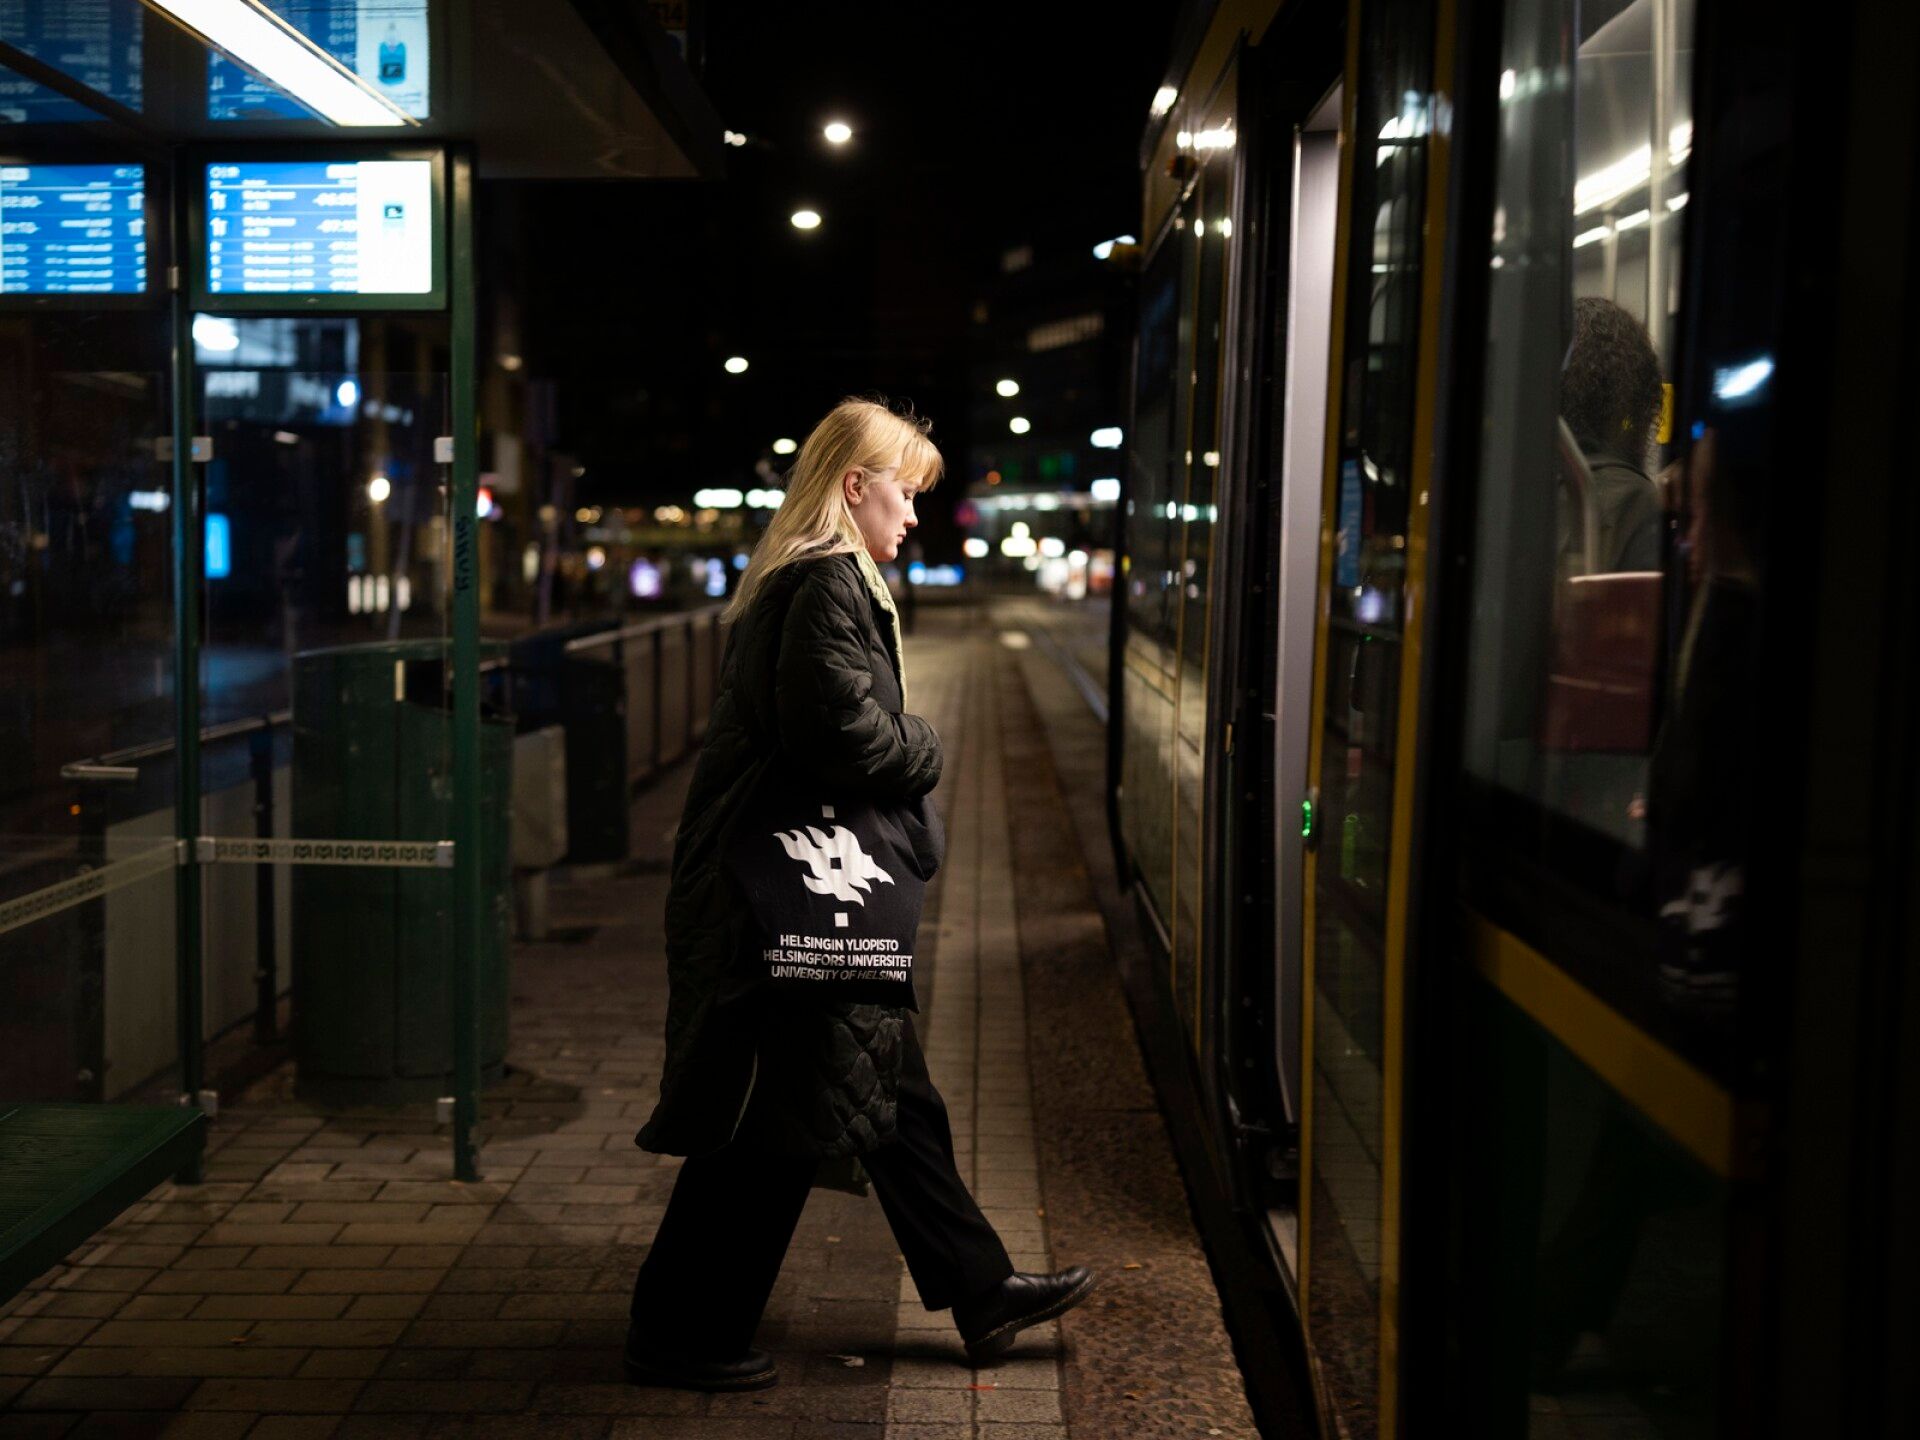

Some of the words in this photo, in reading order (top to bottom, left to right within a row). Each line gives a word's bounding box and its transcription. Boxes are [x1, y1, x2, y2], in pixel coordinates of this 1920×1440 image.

[780, 934, 844, 951] HELSINGIN
[846, 938, 899, 951] YLIOPISTO
[763, 949, 846, 967] HELSINGFORS
[847, 954, 913, 967] UNIVERSITET
[771, 965, 839, 981] UNIVERSITY
[840, 969, 858, 980] OF
[858, 970, 907, 982] HELSINKI
